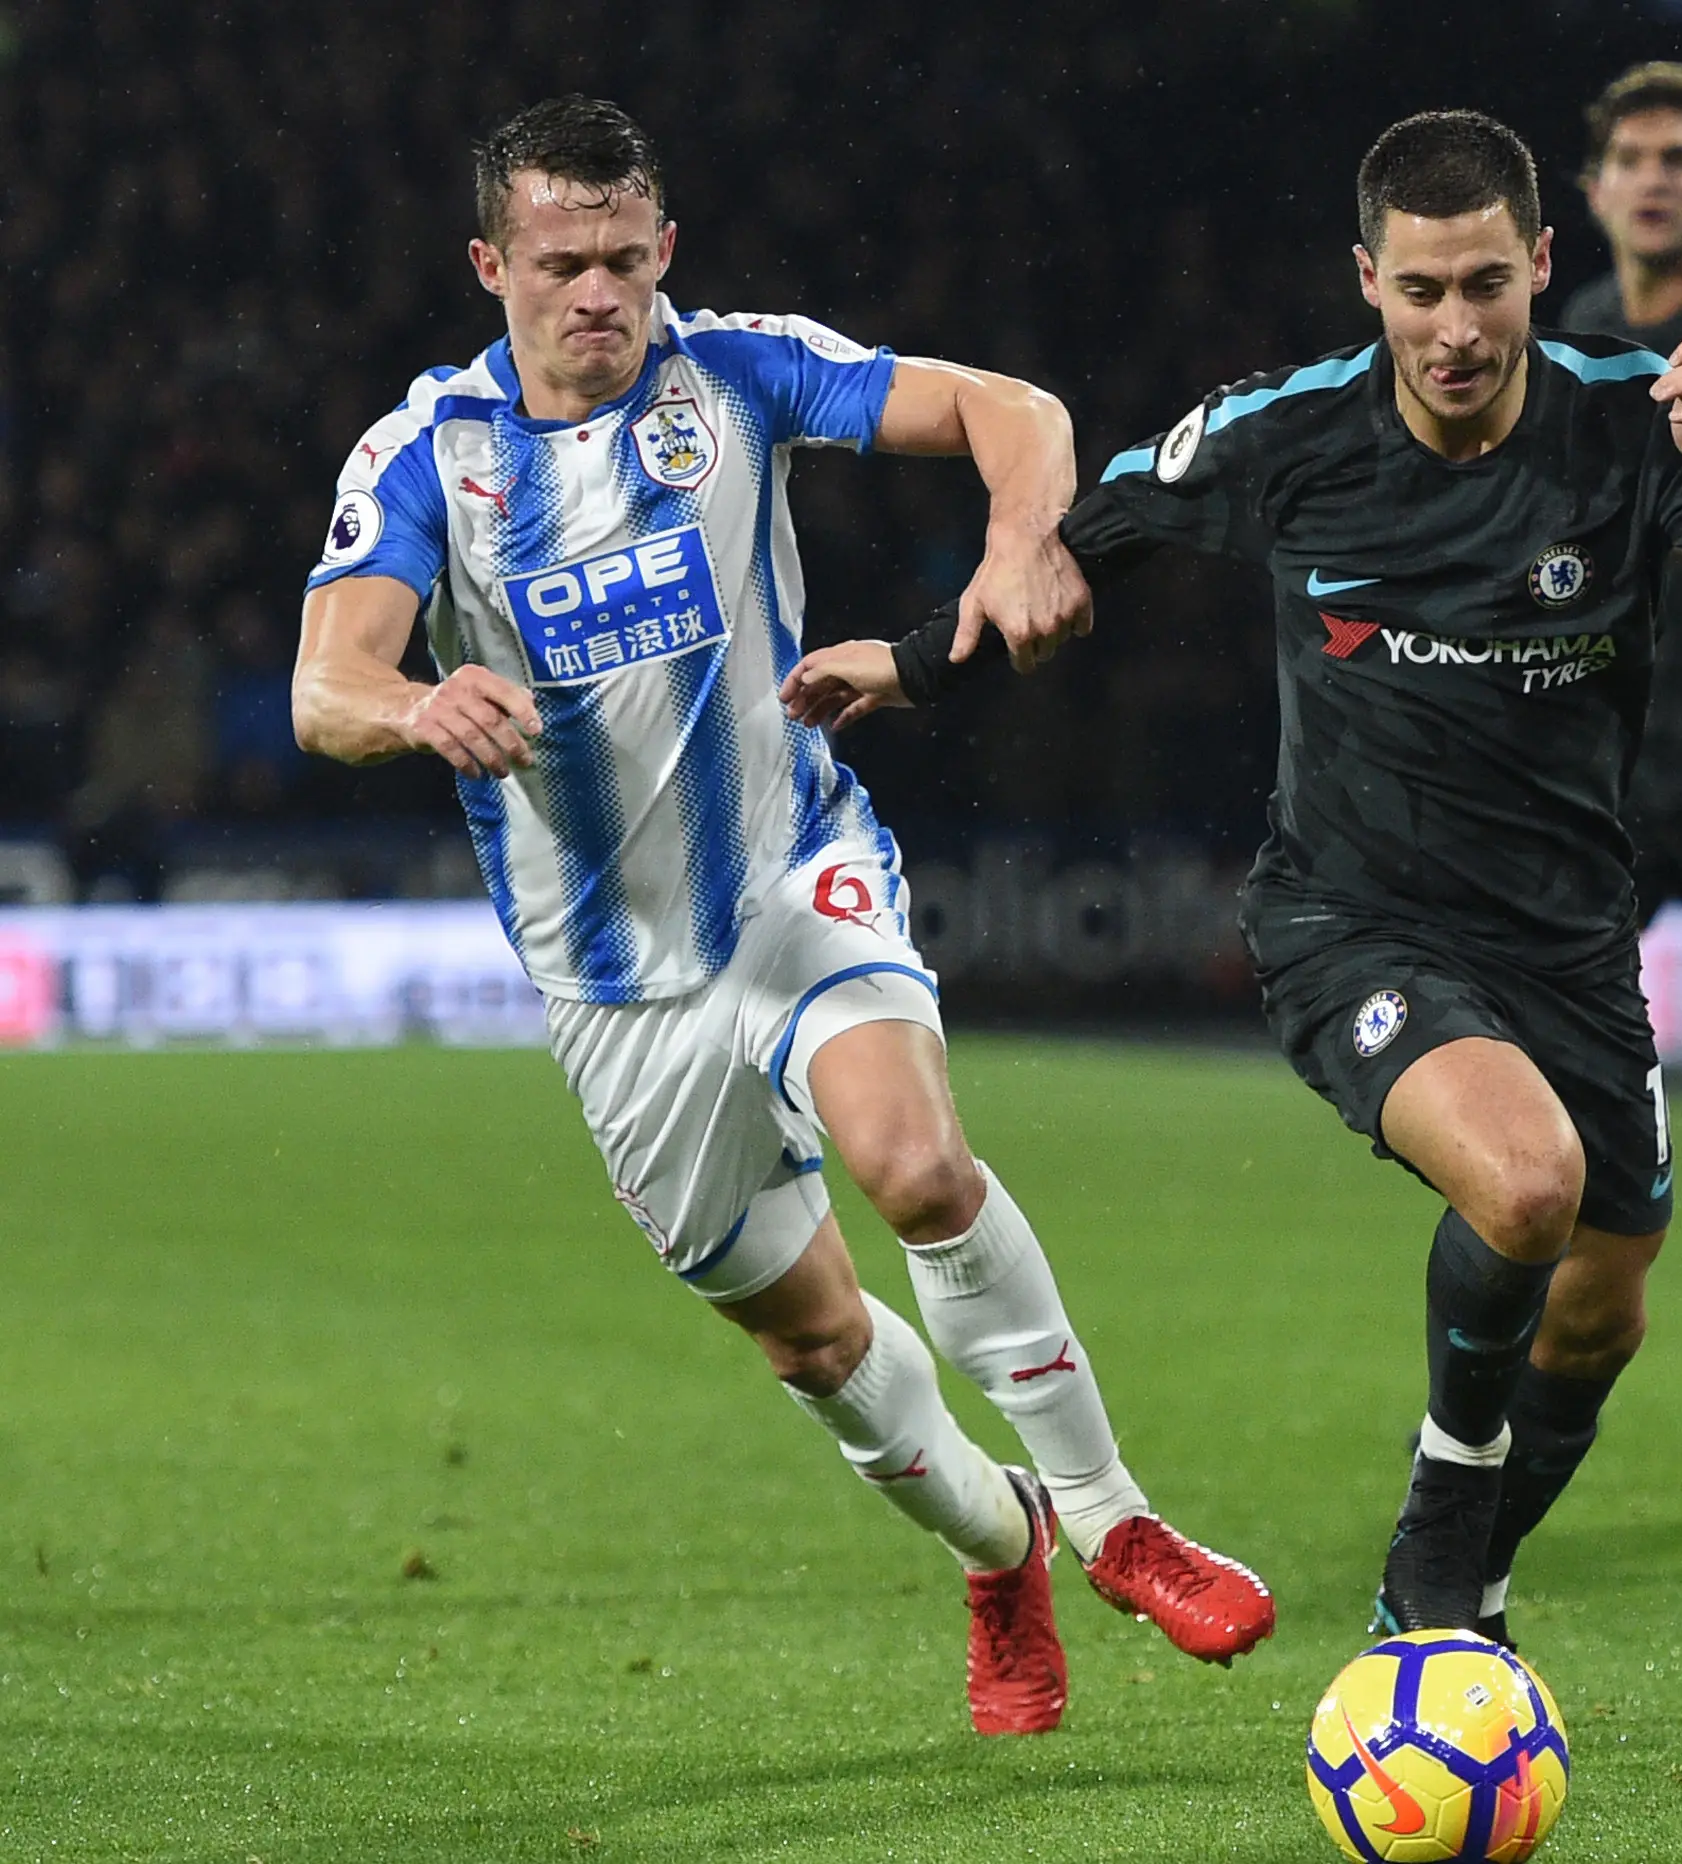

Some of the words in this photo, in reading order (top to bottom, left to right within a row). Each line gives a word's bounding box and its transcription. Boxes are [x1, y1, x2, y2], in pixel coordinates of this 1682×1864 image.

[526, 537, 689, 617] OPE
[543, 589, 690, 637] SPORTS
[544, 605, 706, 678] 体育滚球
[1380, 628, 1616, 664] YOKOHAMA
[1522, 656, 1613, 694] TYRES
[813, 863, 872, 918] 6
[1646, 1063, 1671, 1165] 1
